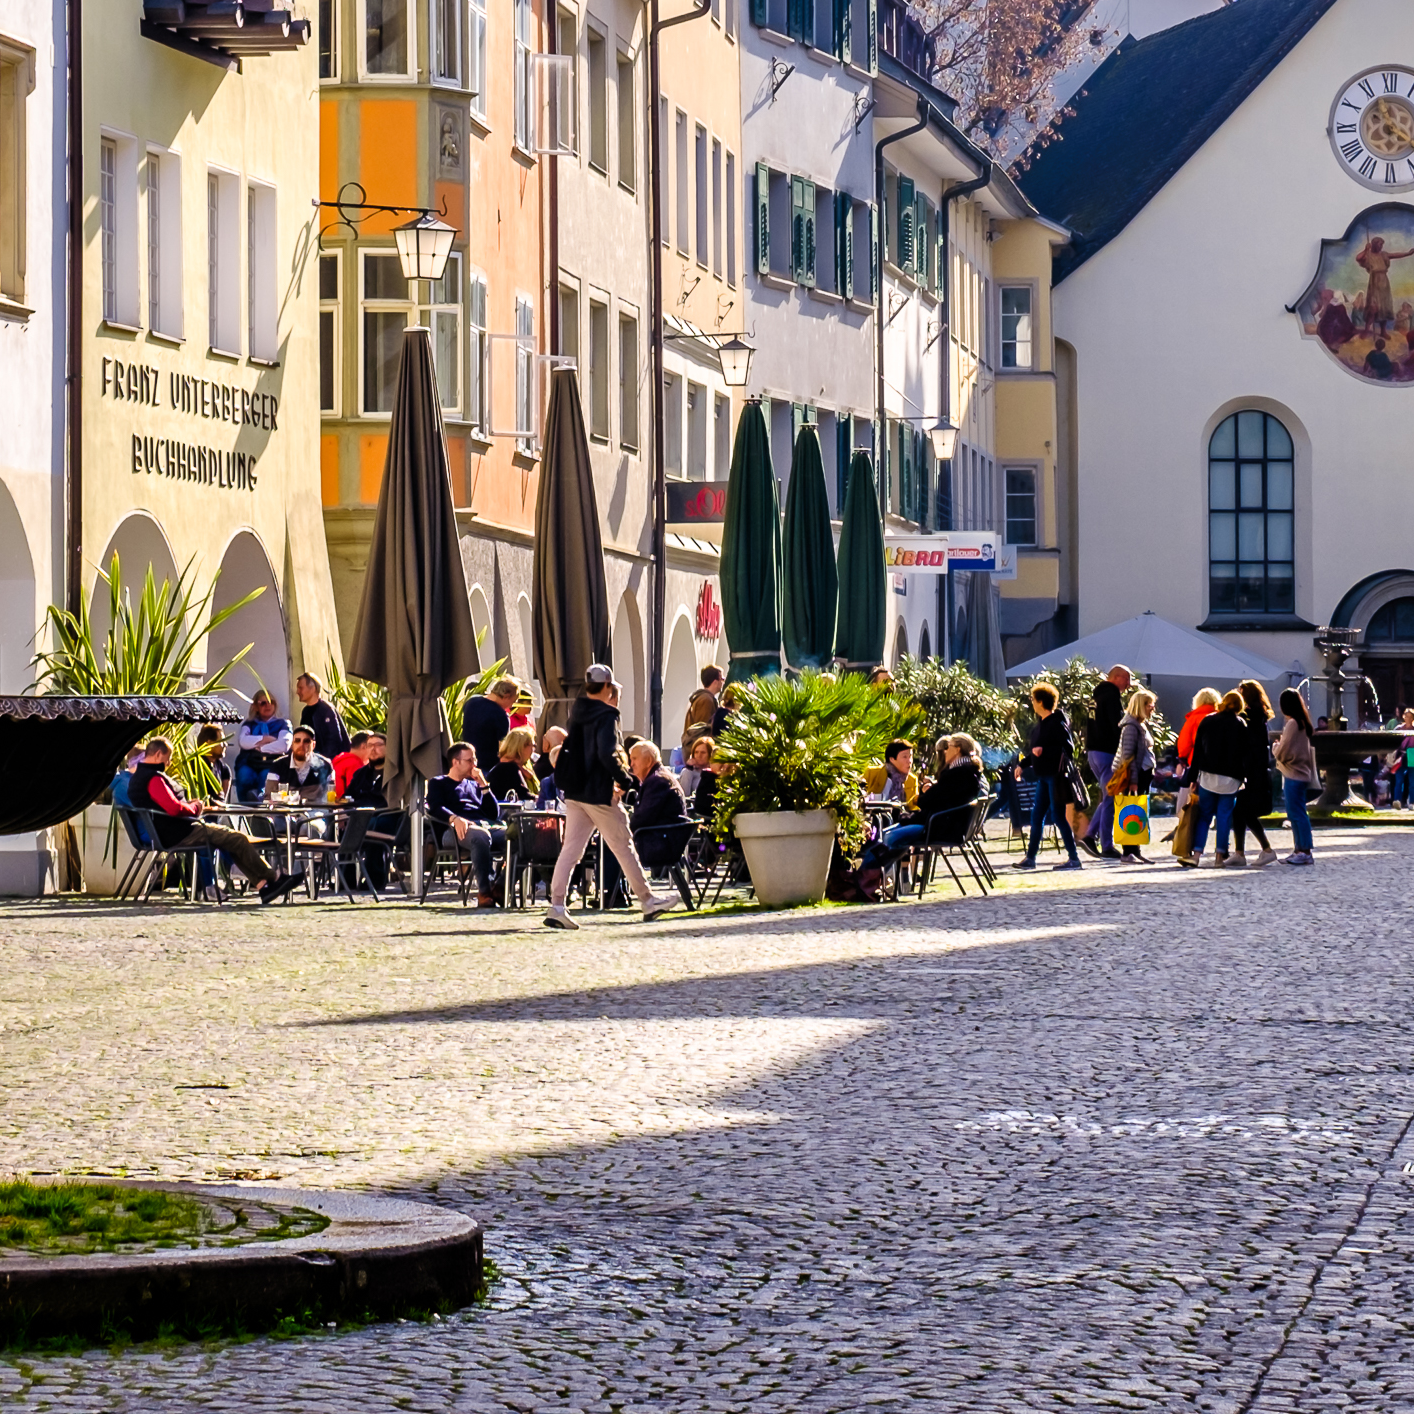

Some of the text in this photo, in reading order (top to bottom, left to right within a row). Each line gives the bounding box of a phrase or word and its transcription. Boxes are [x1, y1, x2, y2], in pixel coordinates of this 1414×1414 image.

[101, 356, 279, 432] FRANZ UNTERBERGER
[132, 432, 258, 492] BUCHHANDLUNG
[685, 487, 726, 518] s.Ol
[947, 547, 979, 557] artlauer
